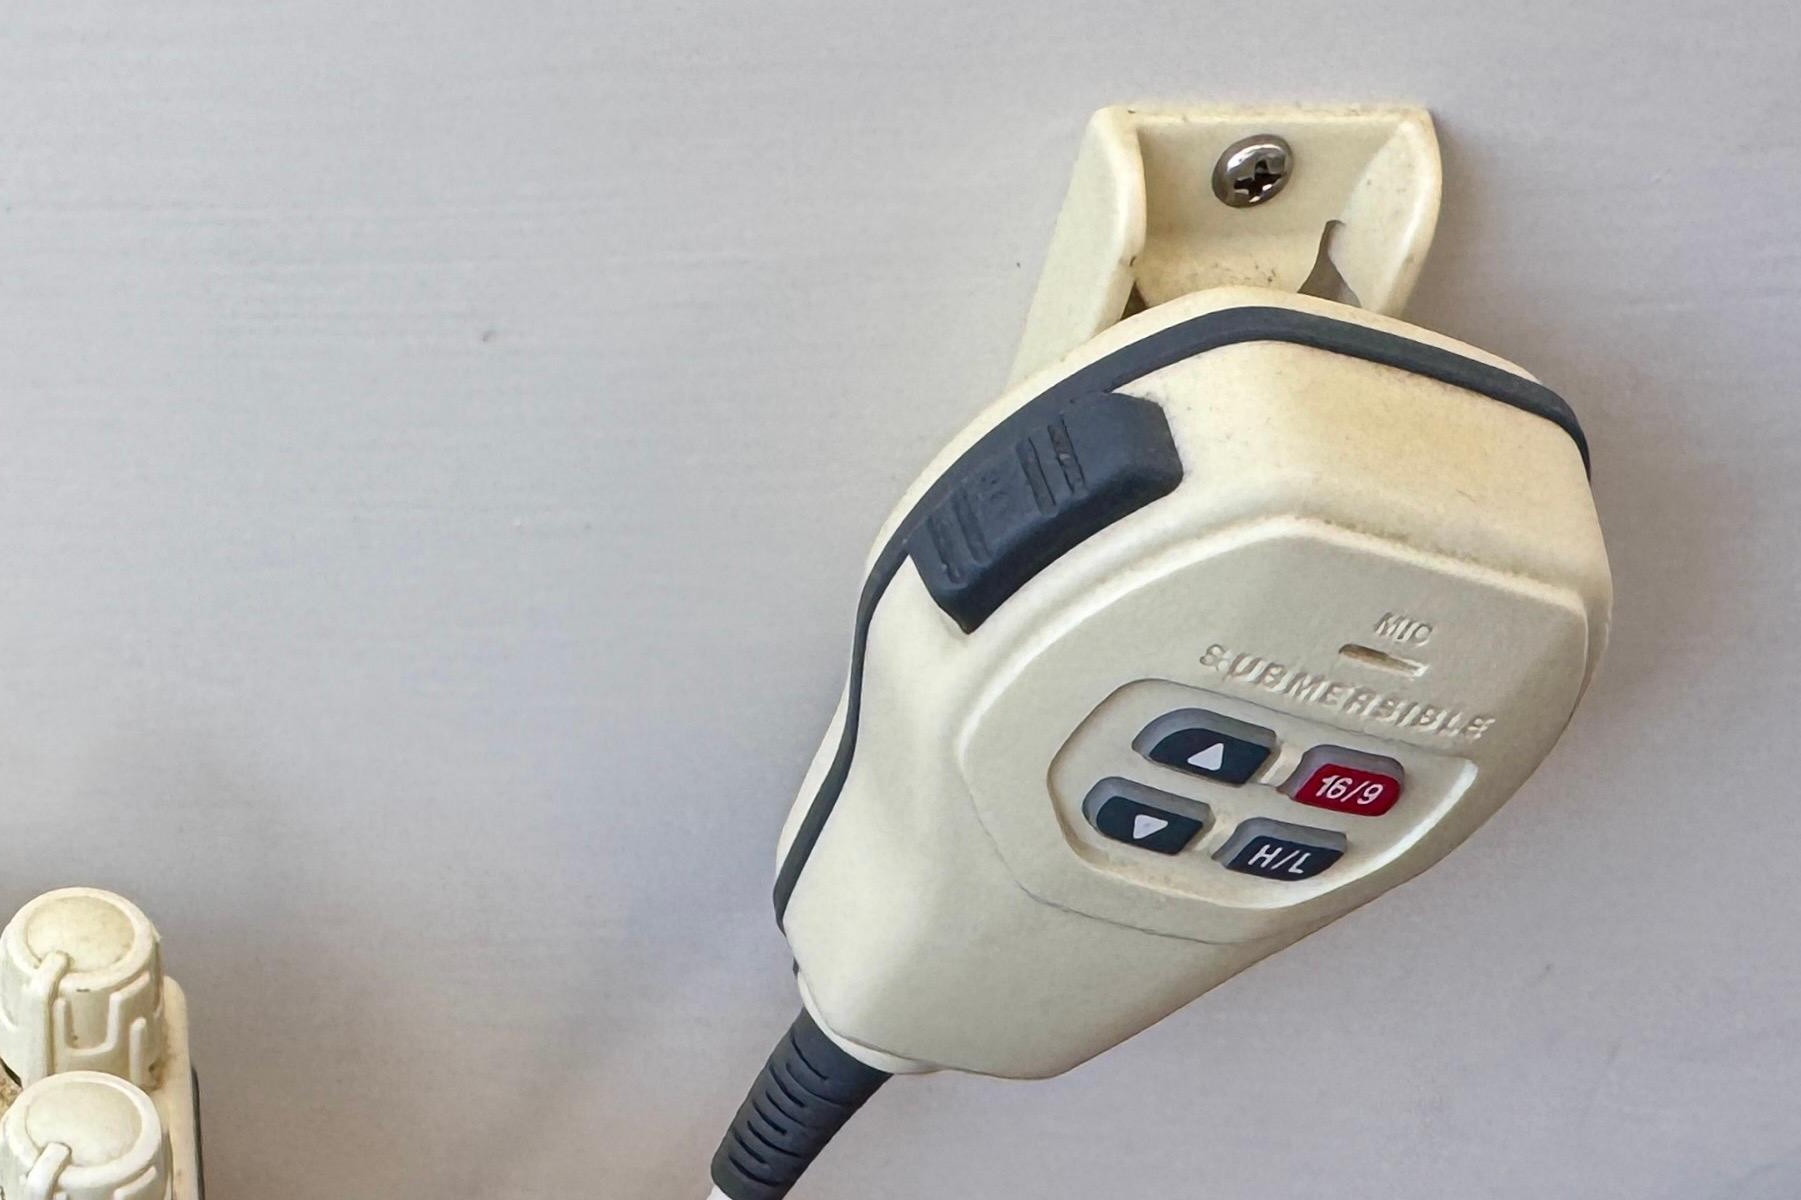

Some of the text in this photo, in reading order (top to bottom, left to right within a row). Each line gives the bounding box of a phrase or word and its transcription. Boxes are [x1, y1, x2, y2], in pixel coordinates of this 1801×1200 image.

[1373, 611, 1433, 647] MIC
[1199, 643, 1497, 741] SUBMERSIBLE
[1315, 774, 1384, 805] 16/9
[1248, 844, 1311, 876] H/L
